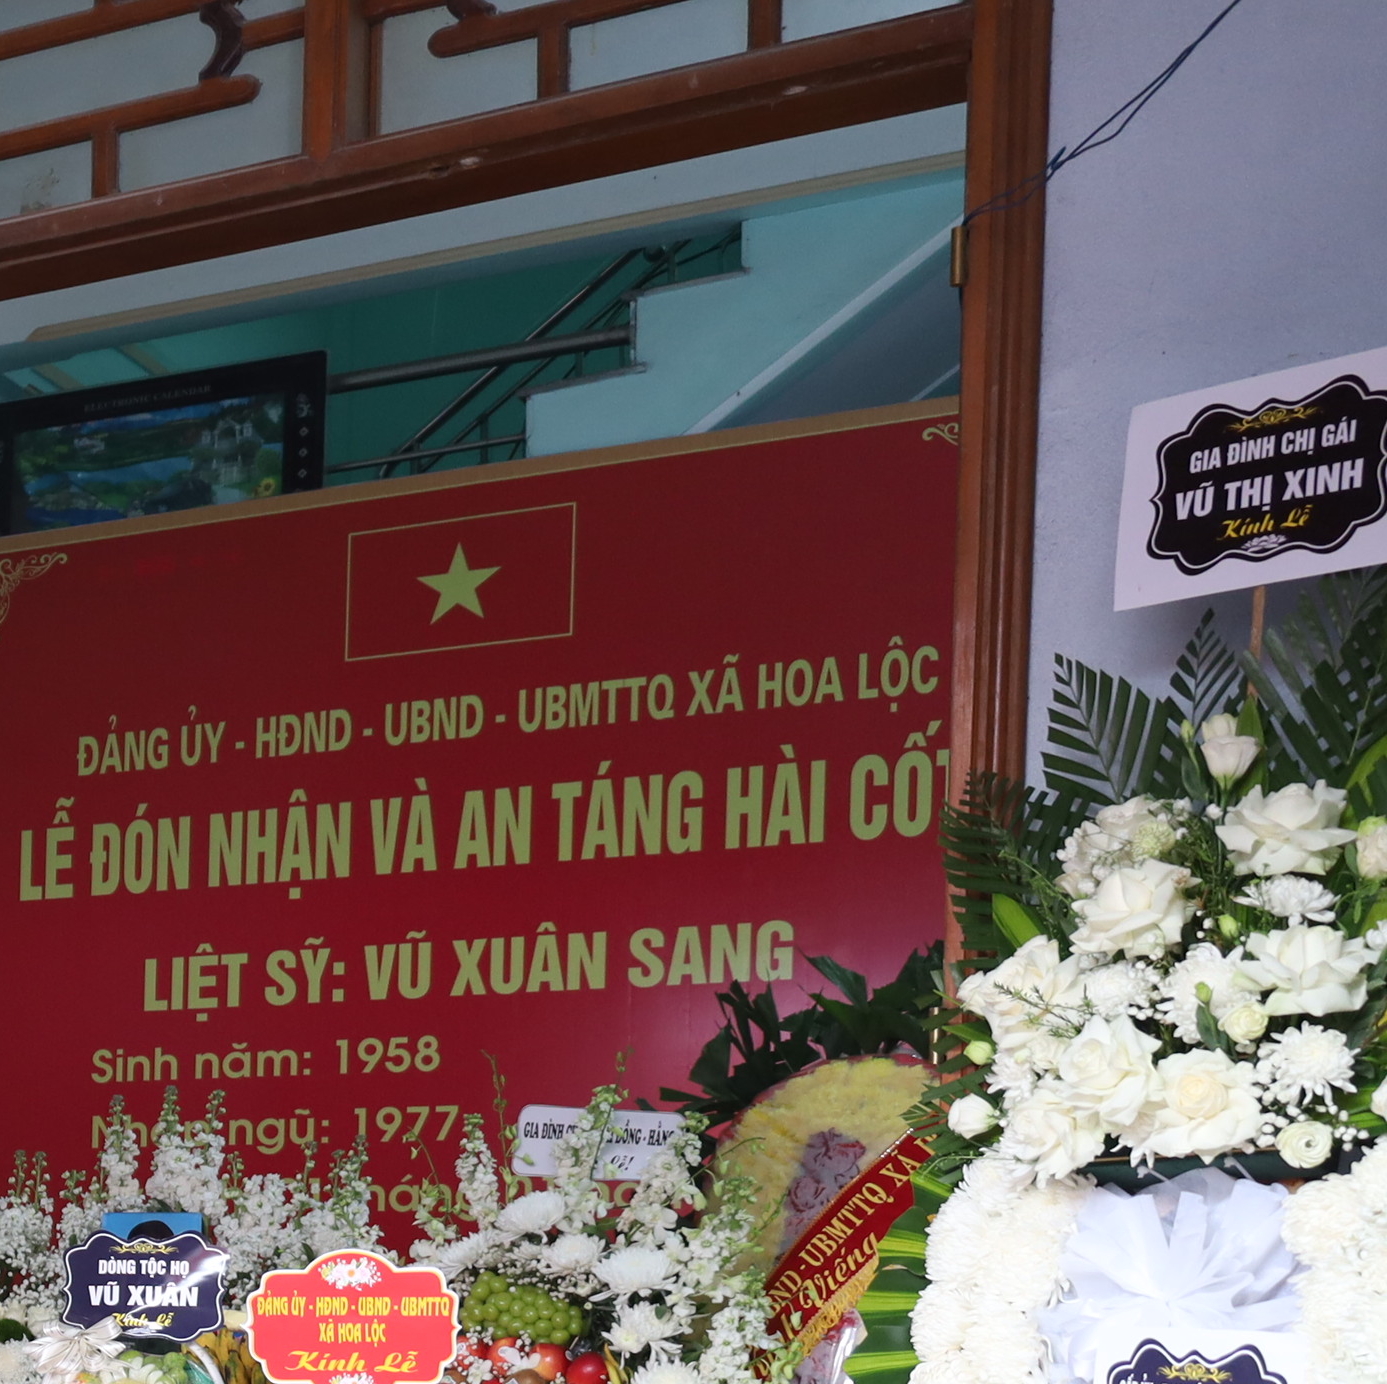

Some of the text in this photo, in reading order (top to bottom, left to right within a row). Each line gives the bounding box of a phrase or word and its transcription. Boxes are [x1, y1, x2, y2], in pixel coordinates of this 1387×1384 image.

[1189, 416, 1357, 474] GIA ĐÌNH CHỊ GÁI
[1175, 457, 1365, 521] VŨ THỊ XINH
[1216, 504, 1314, 541] Kính Lễ
[77, 715, 168, 776] ĐẢNG
[180, 705, 226, 766] ỦY
[256, 709, 352, 759] HĐND
[385, 694, 484, 746] UBND
[518, 674, 675, 733] UBMTTQ
[686, 653, 744, 717] XÃ
[757, 656, 843, 709] HOA
[858, 635, 939, 713] LỘC
[20, 797, 75, 901] LỄ
[90, 803, 191, 896] ĐÓN
[208, 788, 352, 900] NHẬN
[369, 777, 437, 875] VÀ
[453, 785, 532, 869] AN
[552, 760, 704, 861] TÁNG
[725, 744, 826, 850] HÀI
[143, 919, 795, 1022] LIỆT SỸ: VŨ XUÂN SANG
[91, 1035, 441, 1084] Sinh năm: 1958
[229, 1109, 330, 1155] ngũ:
[354, 1105, 459, 1143] 1977
[523, 1121, 539, 1139] GIA
[541, 1118, 564, 1140] ĐÌNH
[879, 1146, 922, 1189] XÃ
[98, 1256, 190, 1279] DÒNG TỘC HỌ
[88, 1281, 199, 1307] VŨ XUÂN
[257, 1290, 289, 1316] ĐẢNG
[291, 1290, 307, 1317] ỦY
[316, 1296, 348, 1318] HĐND
[358, 1296, 391, 1316] UBND
[400, 1296, 450, 1317] UBMTTQ
[154, 1312, 175, 1327] Lễ
[319, 1318, 386, 1348] XÃ HOA LỘC
[284, 1350, 419, 1373] Kính Lễ
